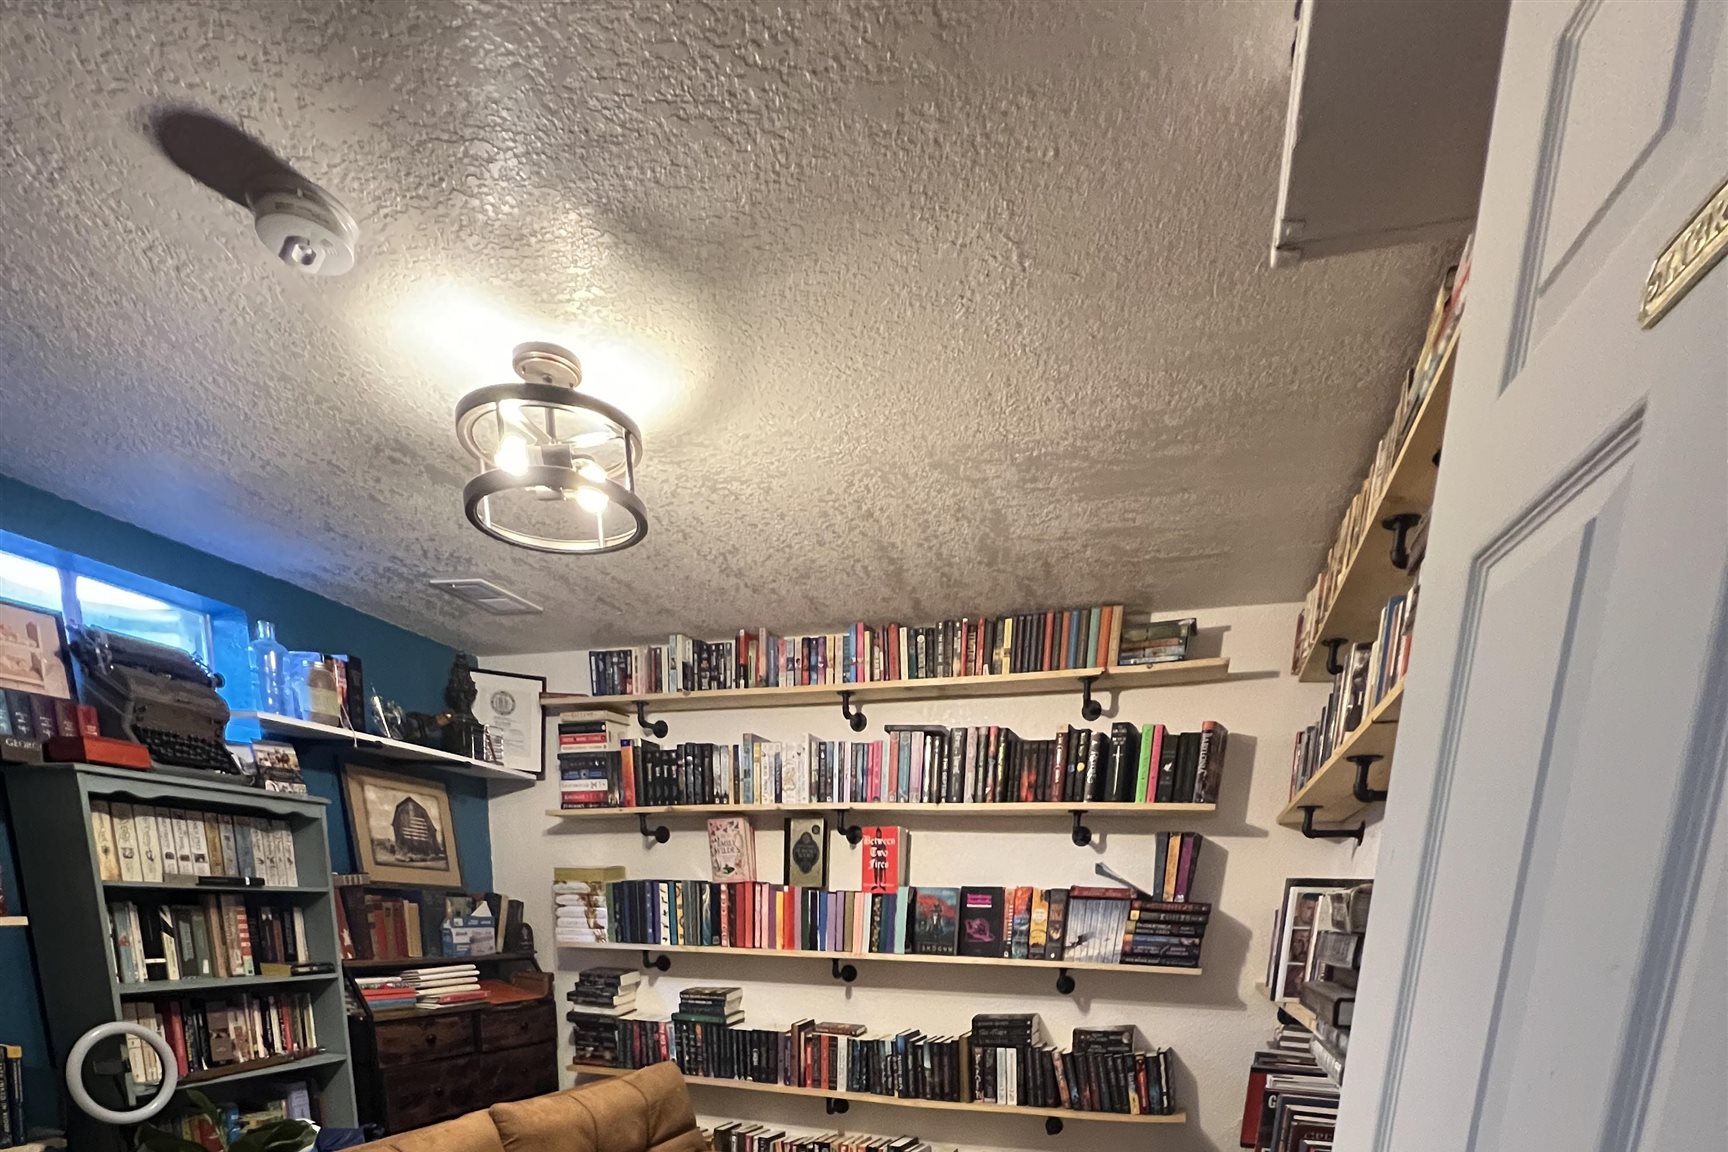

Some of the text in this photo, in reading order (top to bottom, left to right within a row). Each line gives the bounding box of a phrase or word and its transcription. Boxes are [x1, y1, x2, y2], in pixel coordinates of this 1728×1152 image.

[863, 835, 896, 847] Between
[870, 846, 889, 857] Two
[868, 858, 889, 871] Fires
